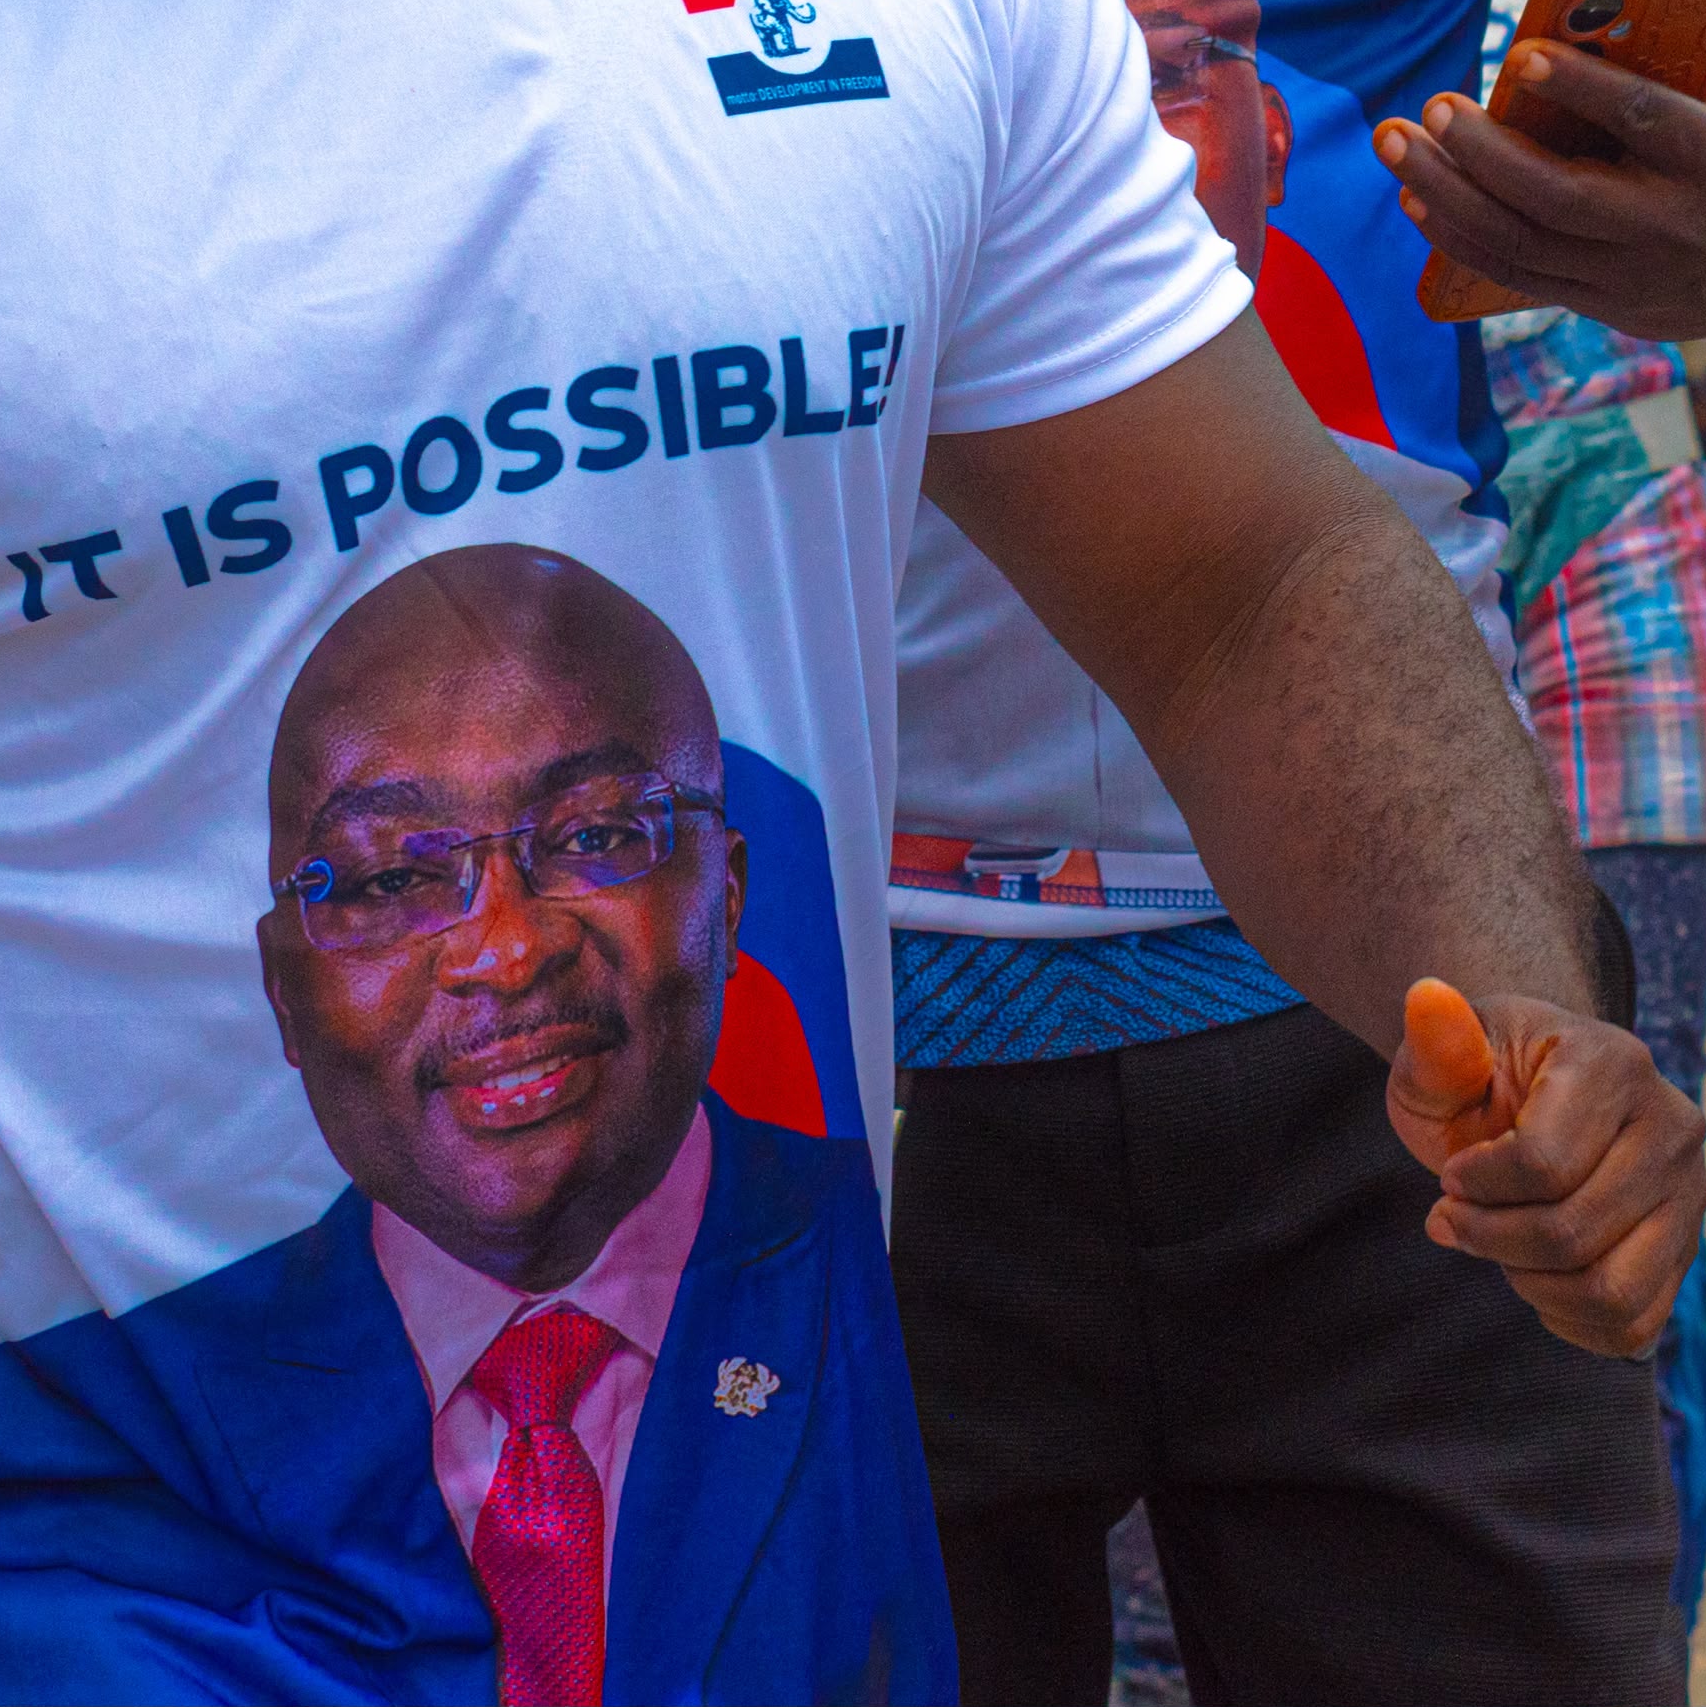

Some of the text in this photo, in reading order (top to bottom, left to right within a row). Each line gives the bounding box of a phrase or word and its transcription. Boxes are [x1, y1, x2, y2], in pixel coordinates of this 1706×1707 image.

[757, 79, 829, 101] DEVELOPMENT
[827, 78, 841, 93] IN
[839, 74, 884, 92] FREEDOM
[6, 322, 906, 624] IT IS POSSIBLE!
